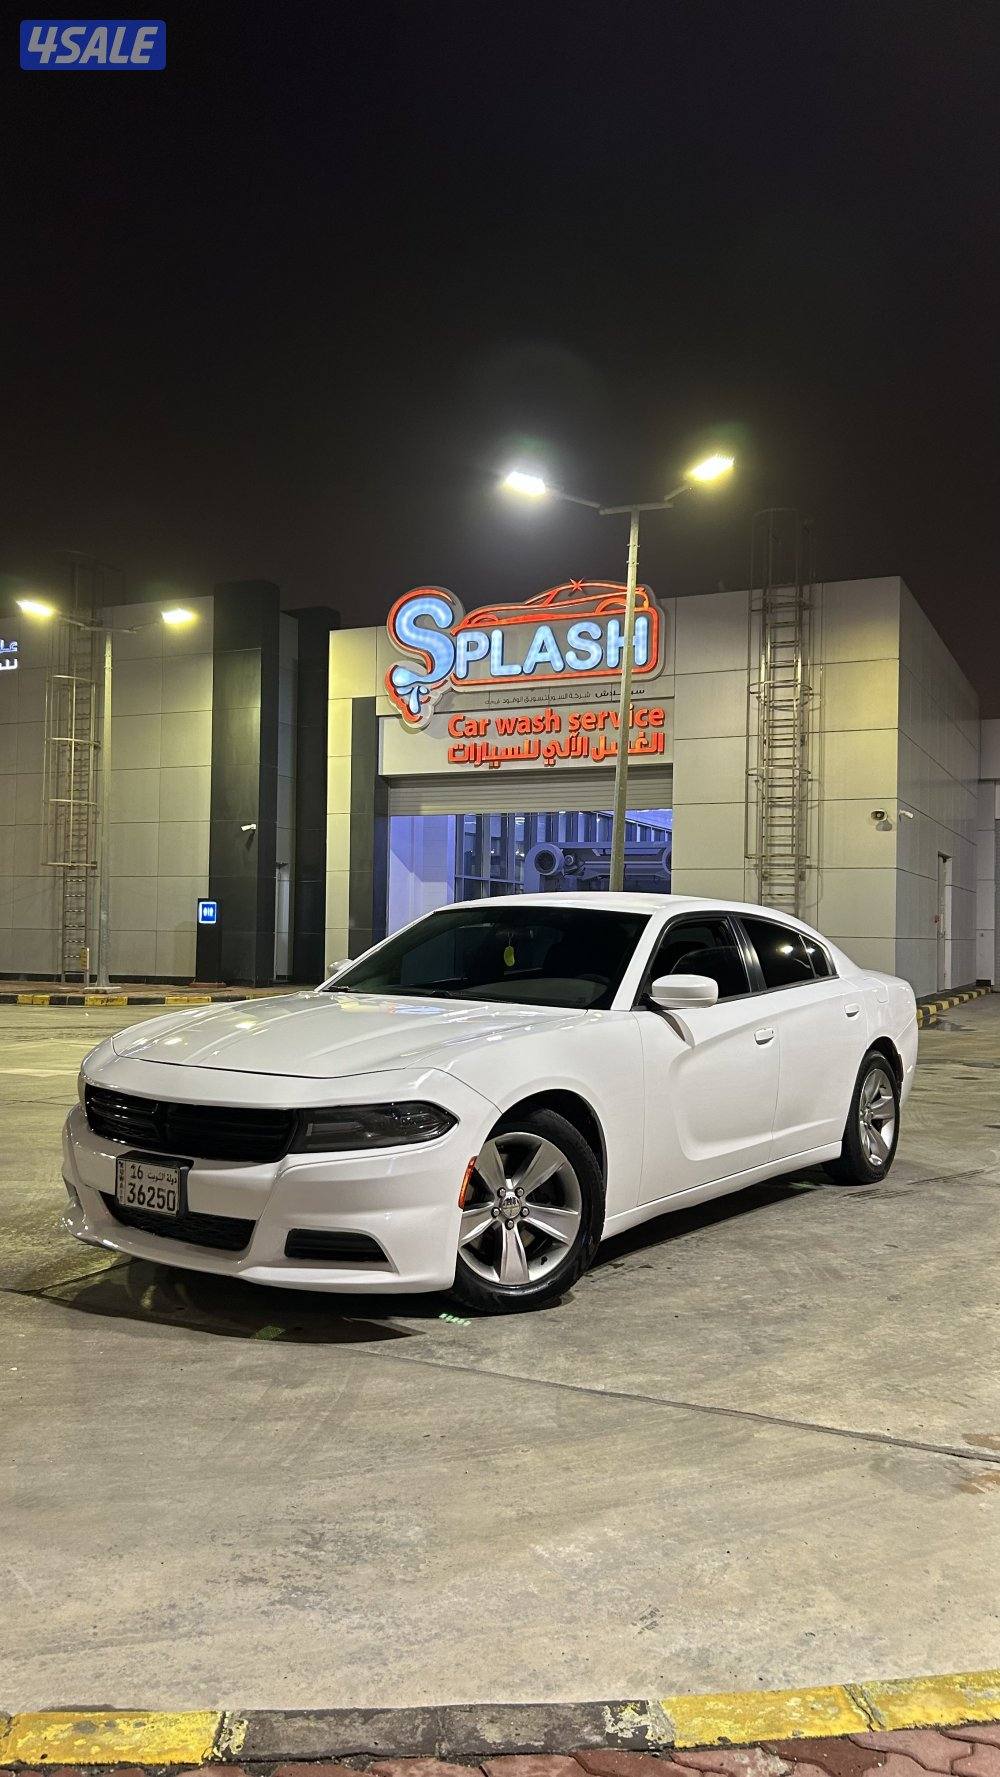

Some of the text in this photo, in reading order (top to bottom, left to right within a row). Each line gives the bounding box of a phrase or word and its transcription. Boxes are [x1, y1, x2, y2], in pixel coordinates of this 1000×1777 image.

[392, 596, 649, 687] SPLASH
[448, 704, 665, 738] Car wash service
[448, 737, 541, 769] للسيارات
[543, 732, 589, 766] الآلي
[130, 1164, 144, 1180] 16
[147, 1171, 178, 1186] دولة الكويت
[127, 1182, 176, 1212] 36250
